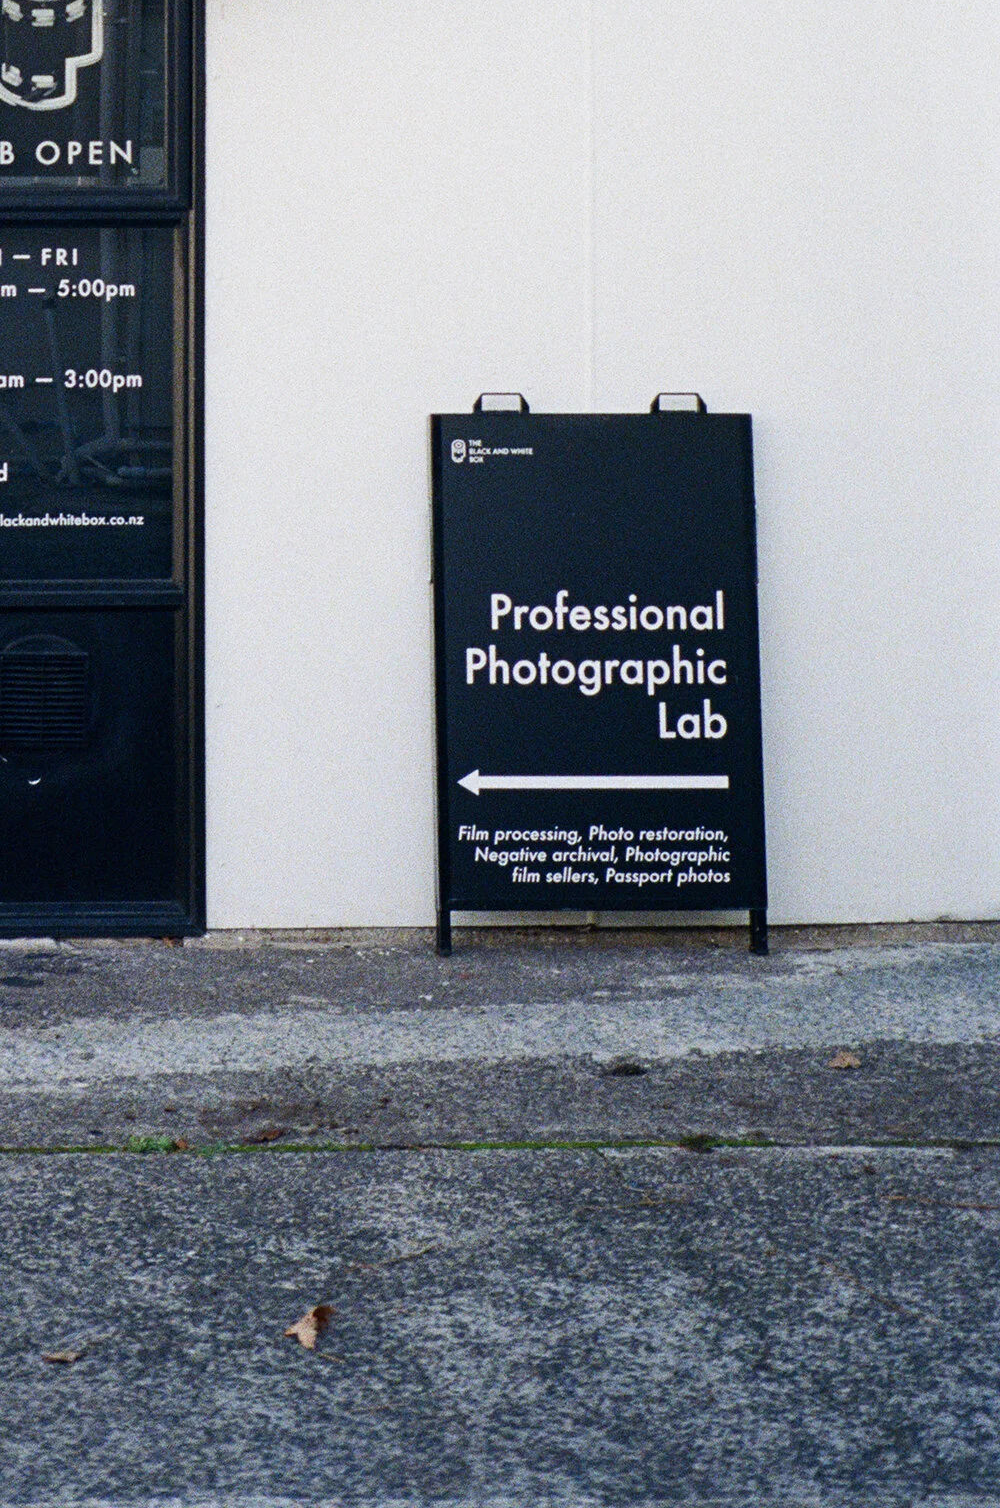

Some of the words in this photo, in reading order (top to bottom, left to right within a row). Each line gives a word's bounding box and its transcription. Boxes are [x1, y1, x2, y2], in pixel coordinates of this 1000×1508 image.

[35, 139, 133, 166] OPEN
[41, 247, 78, 266] FRI
[57, 278, 136, 303] 5:00pm
[63, 368, 143, 394] 3:00pm
[468, 439, 482, 447] THE
[468, 447, 492, 456] BLACK
[492, 447, 510, 456] AND
[509, 447, 534, 456] WHITE
[468, 455, 484, 464] BOX
[490, 589, 725, 631] Professional
[465, 644, 727, 697] Photographic
[658, 698, 728, 740] Lab
[458, 824, 490, 841] Film
[493, 825, 583, 846] processing,
[588, 824, 635, 842] Photo
[639, 825, 729, 843] restoration,
[474, 846, 548, 867] Negative
[551, 845, 619, 865] archival,
[625, 845, 731, 867] Photographic
[511, 866, 541, 883] film
[545, 866, 600, 885] sellers,
[605, 867, 674, 888] Passport
[676, 866, 731, 888] photos
